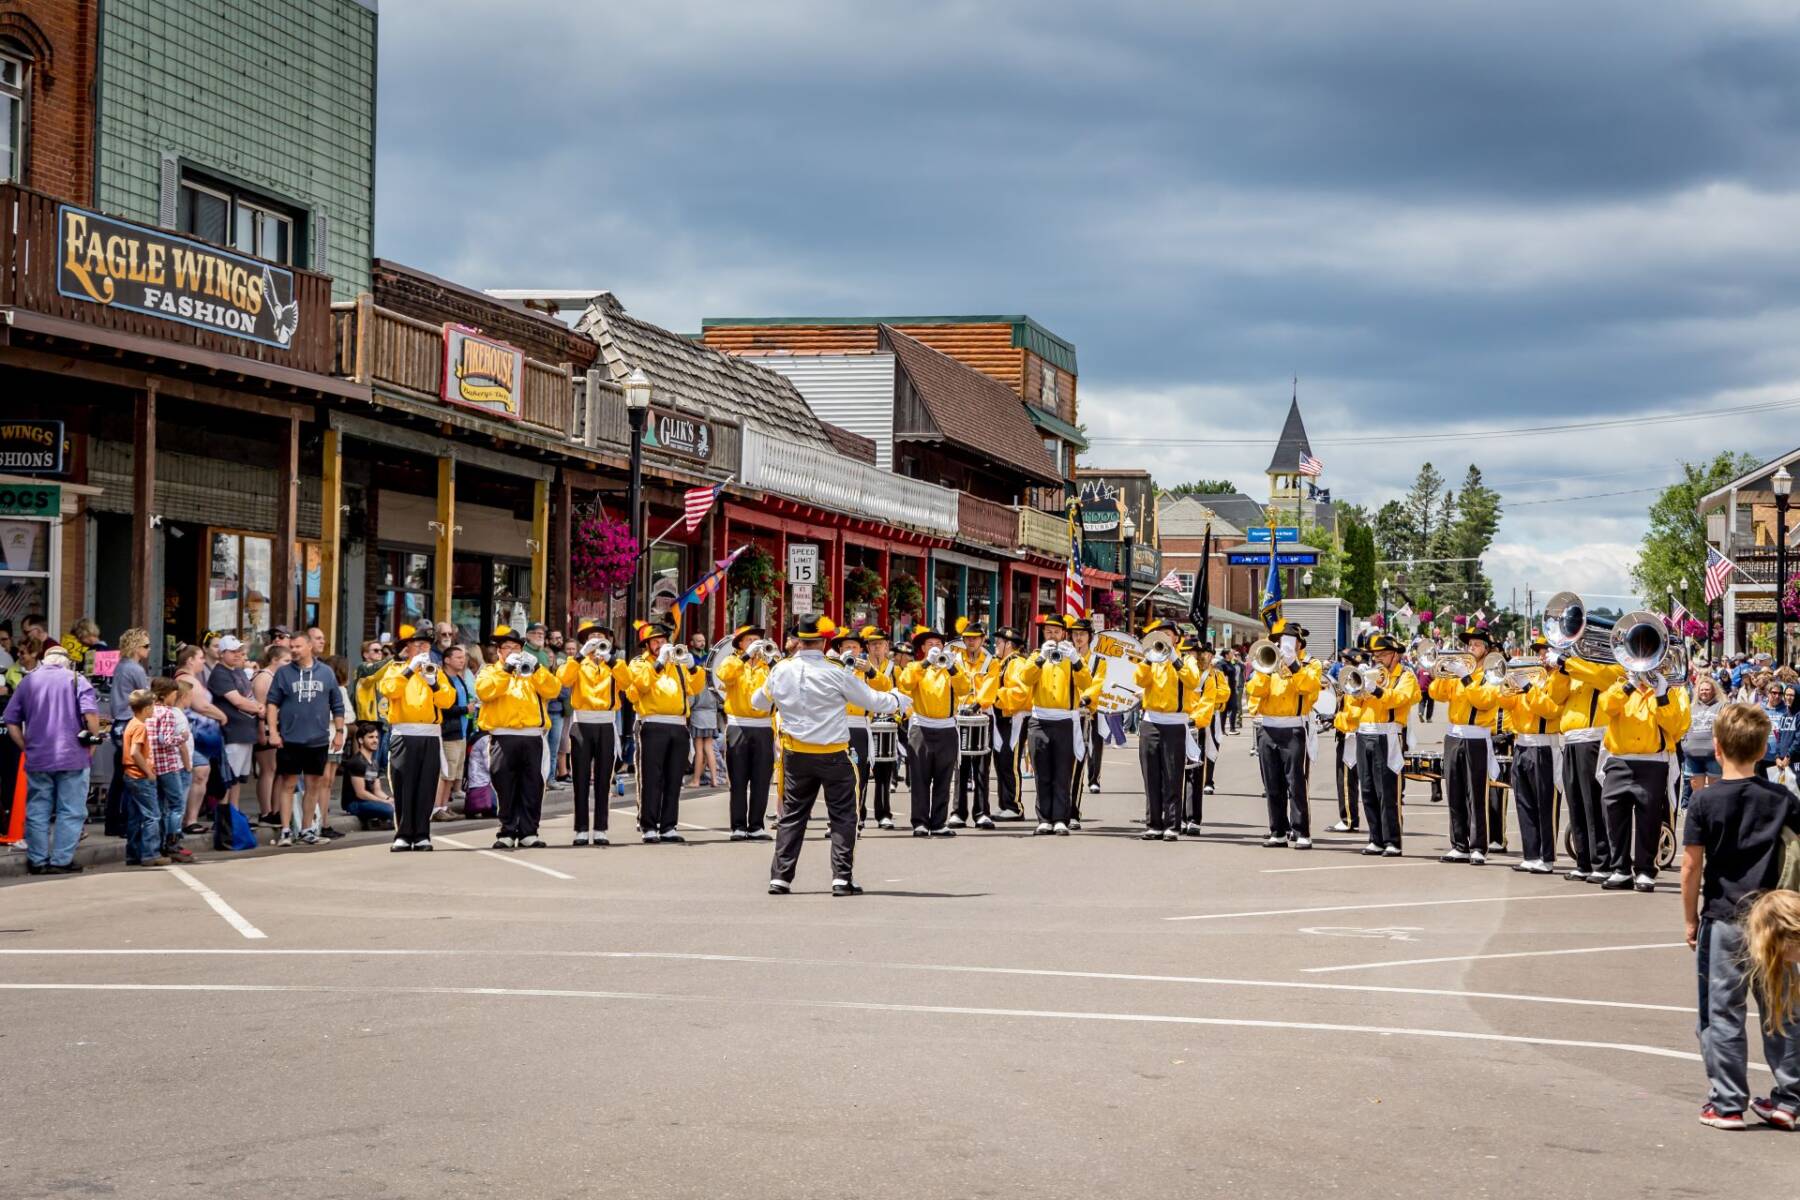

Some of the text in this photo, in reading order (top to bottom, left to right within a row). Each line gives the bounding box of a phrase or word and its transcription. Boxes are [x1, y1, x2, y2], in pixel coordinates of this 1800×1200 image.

[65, 212, 263, 315] EAGLE WINGS
[143, 287, 257, 334] FASHION
[463, 339, 514, 390] FIREHOUSE
[1, 424, 54, 447] WINGS
[660, 416, 694, 446] GLIK'S
[796, 565, 812, 580] 15
